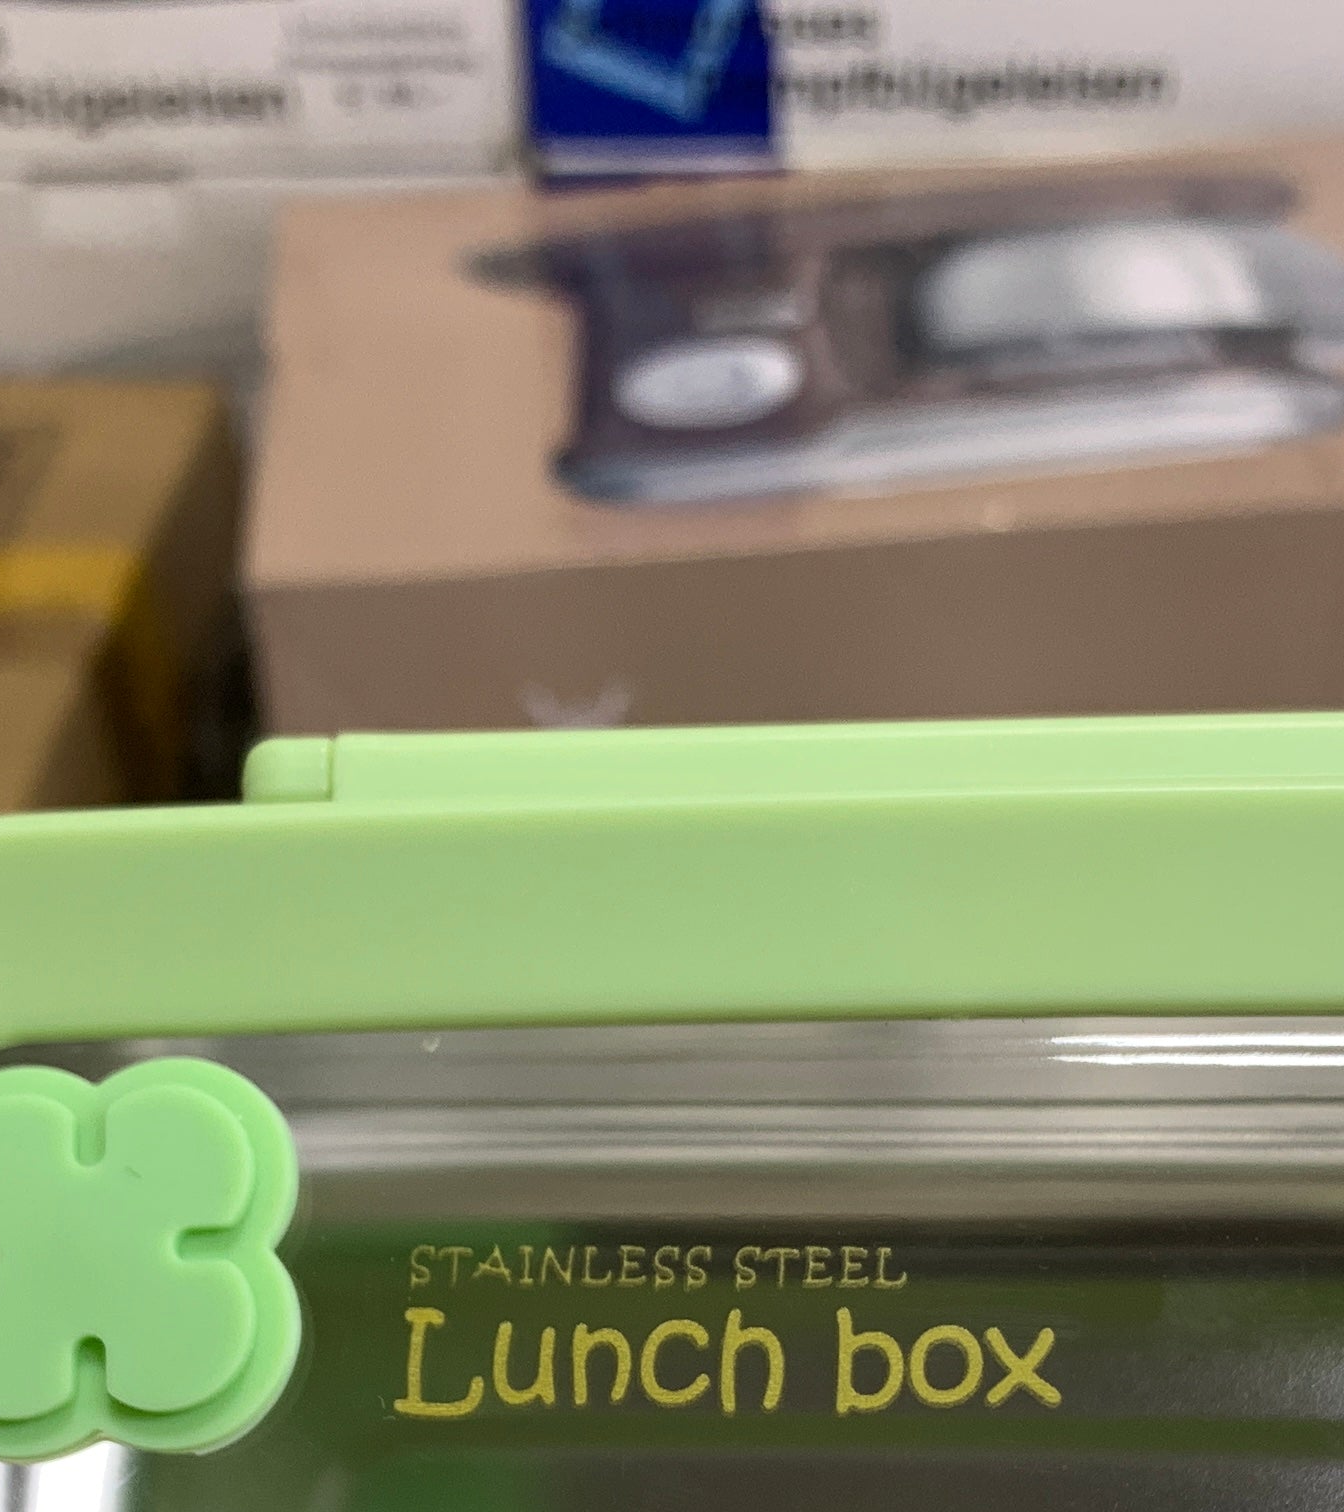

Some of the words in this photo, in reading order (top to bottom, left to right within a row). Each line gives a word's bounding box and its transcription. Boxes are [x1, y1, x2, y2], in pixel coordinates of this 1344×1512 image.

[408, 1244, 713, 1291] STAINLESS
[733, 1246, 909, 1291] STEEL
[393, 1307, 786, 1418] Lunch
[835, 1307, 1062, 1416] box
